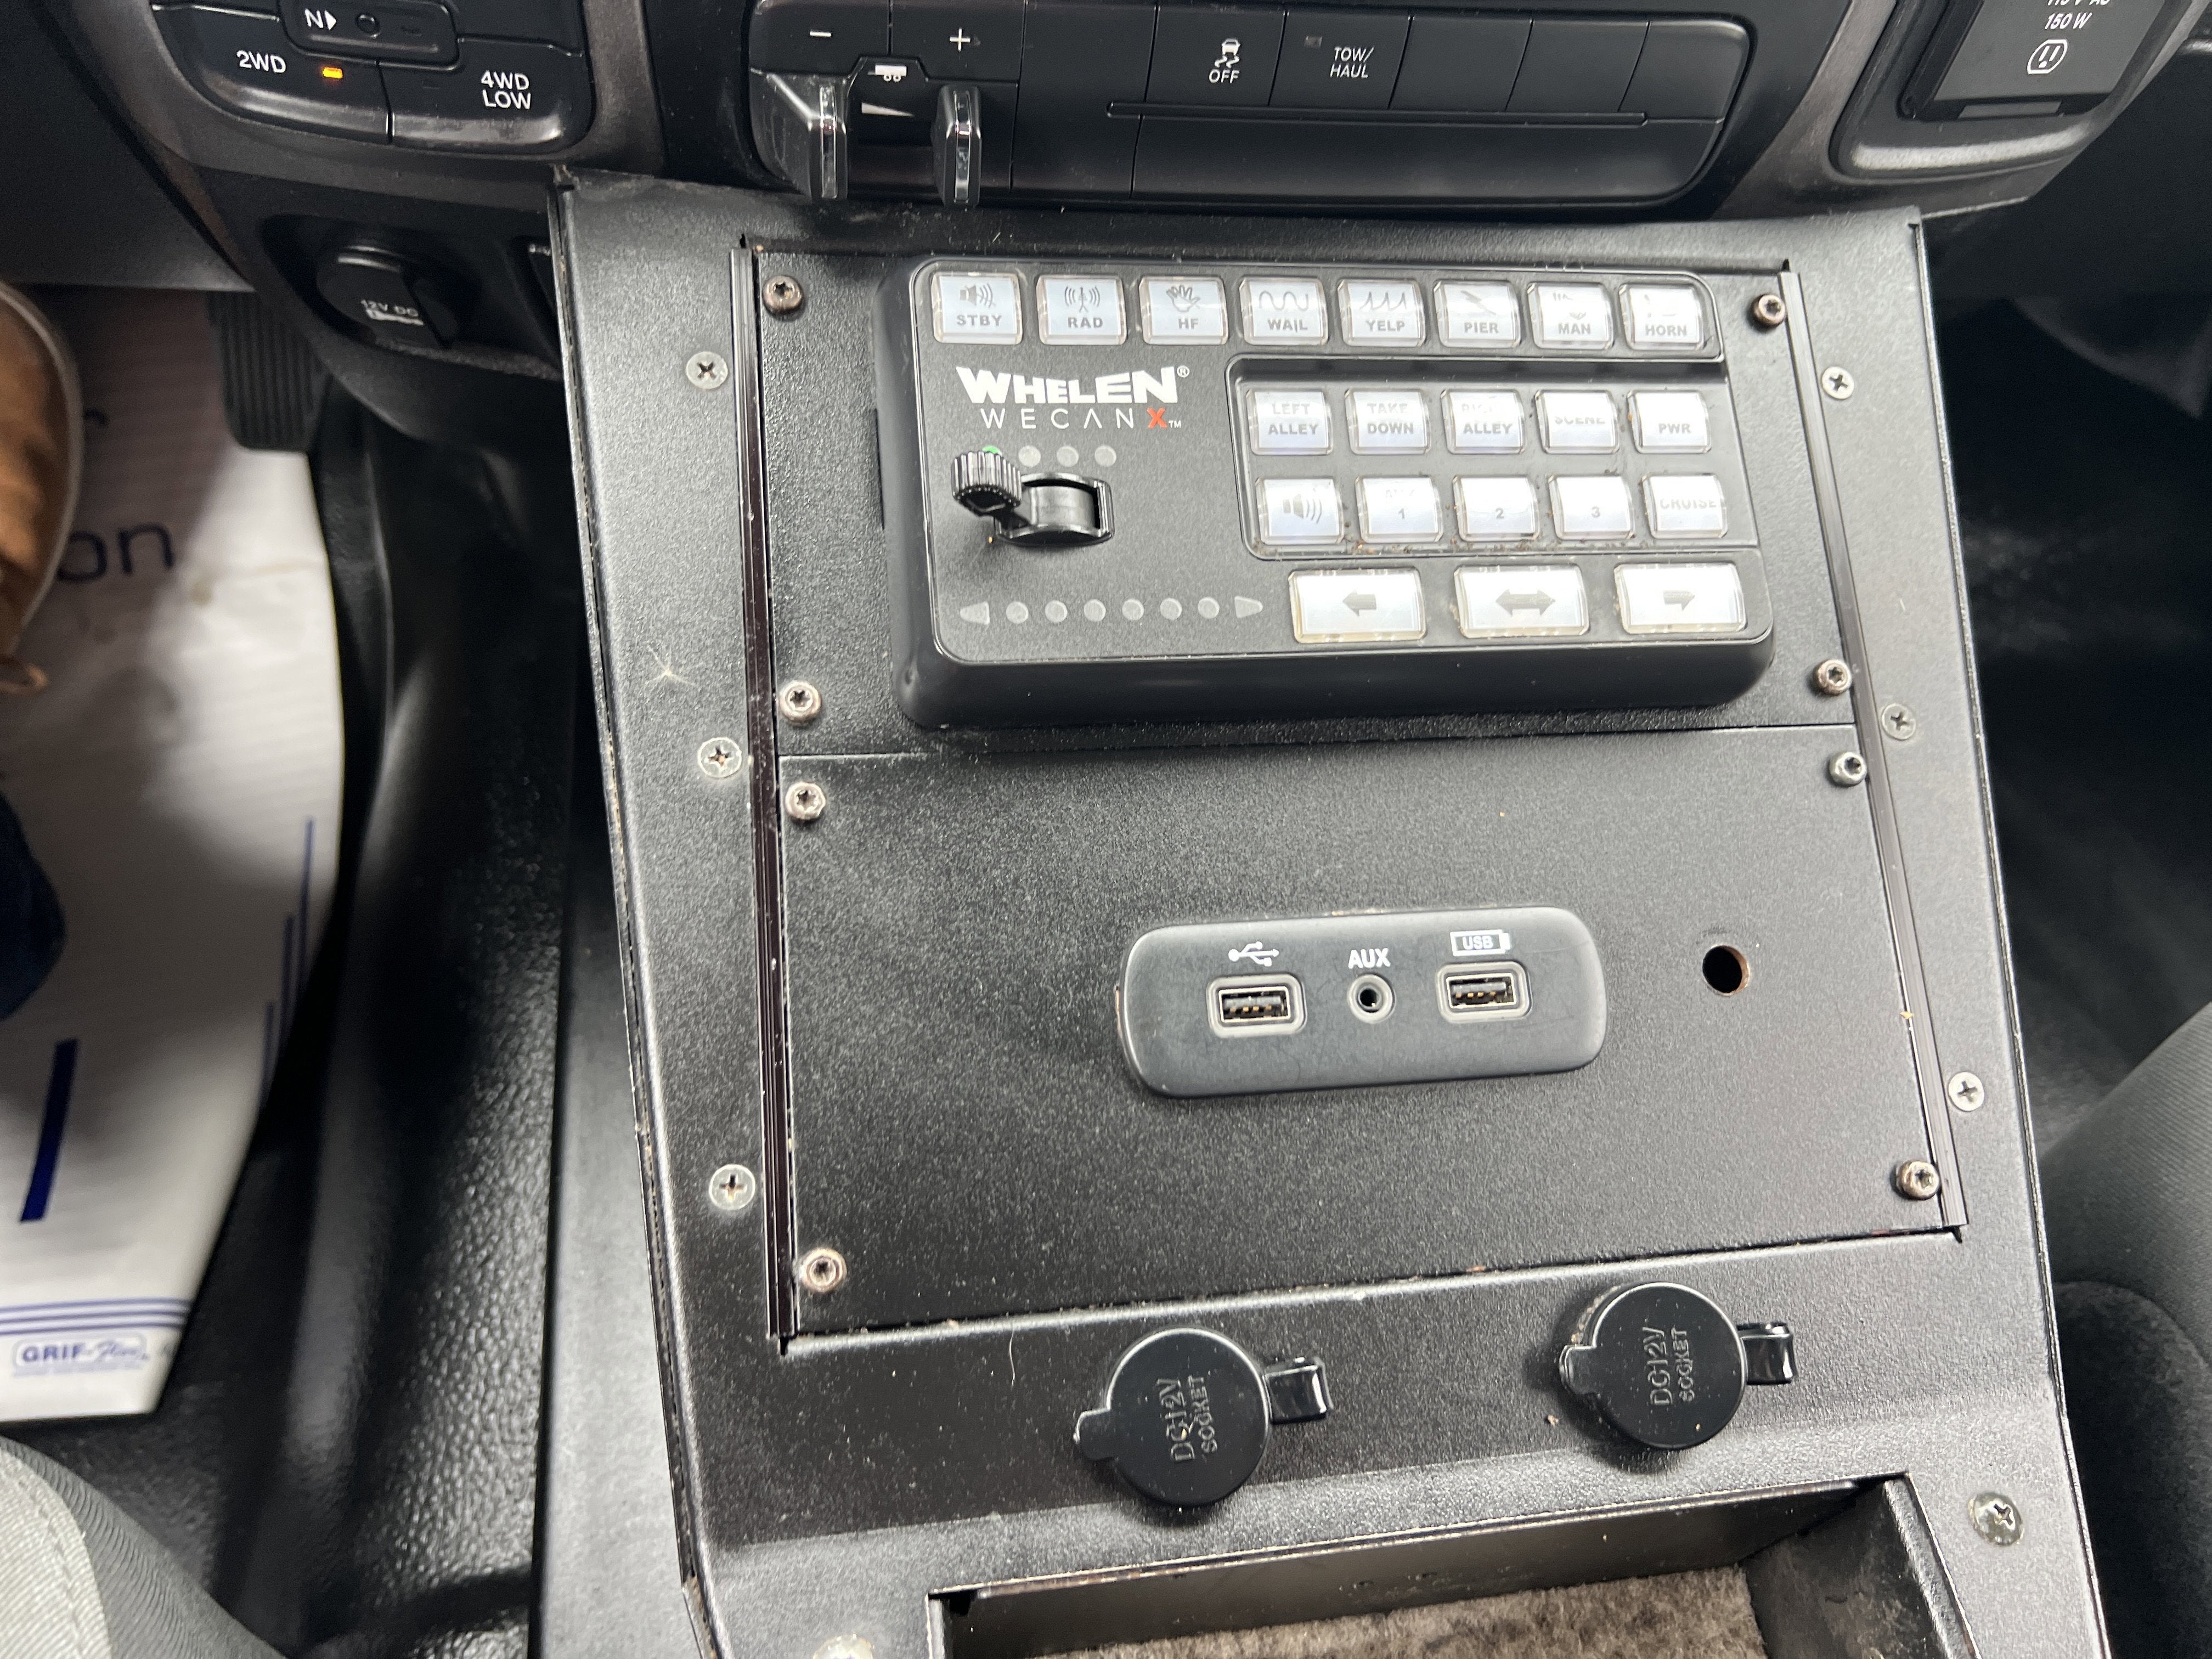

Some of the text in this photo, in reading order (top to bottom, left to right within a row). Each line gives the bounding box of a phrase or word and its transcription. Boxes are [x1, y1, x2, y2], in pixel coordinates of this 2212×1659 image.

[2045, 12, 2092, 30] 150 W
[1334, 47, 1374, 63] TOW/
[236, 50, 286, 74] 2WD
[1209, 69, 1240, 83] OFF
[1329, 64, 1369, 78] HAUL
[481, 71, 529, 90] 4WD
[482, 89, 531, 110] LOW
[360, 299, 419, 317] 12V DC
[956, 314, 1002, 327] STBY
[1068, 317, 1104, 329] RAD
[1178, 318, 1199, 330] HF
[1267, 319, 1308, 332] WAIL
[1365, 320, 1406, 332] YELP
[1464, 322, 1499, 334] PIER
[1558, 323, 1592, 335] MAN
[1645, 324, 1688, 337] HORN
[1272, 403, 1311, 415] LEFT
[1268, 423, 1319, 436] ALLEY
[1367, 422, 1414, 435] DOWN
[1463, 422, 1514, 435] ALLEY
[1658, 423, 1691, 435] PWR
[1660, 498, 1717, 510] CRUISE
[1398, 507, 1405, 520] 1
[1495, 507, 1505, 520] 2
[1591, 506, 1600, 518] 3
[1462, 935, 1493, 950] USB
[1348, 947, 1391, 969] AUX
[1641, 1326, 1673, 1406] DC12V
[1671, 1327, 1695, 1402] SOCKET
[1156, 1378, 1195, 1462] DC12V
[1188, 1375, 1218, 1454] SOCKET
